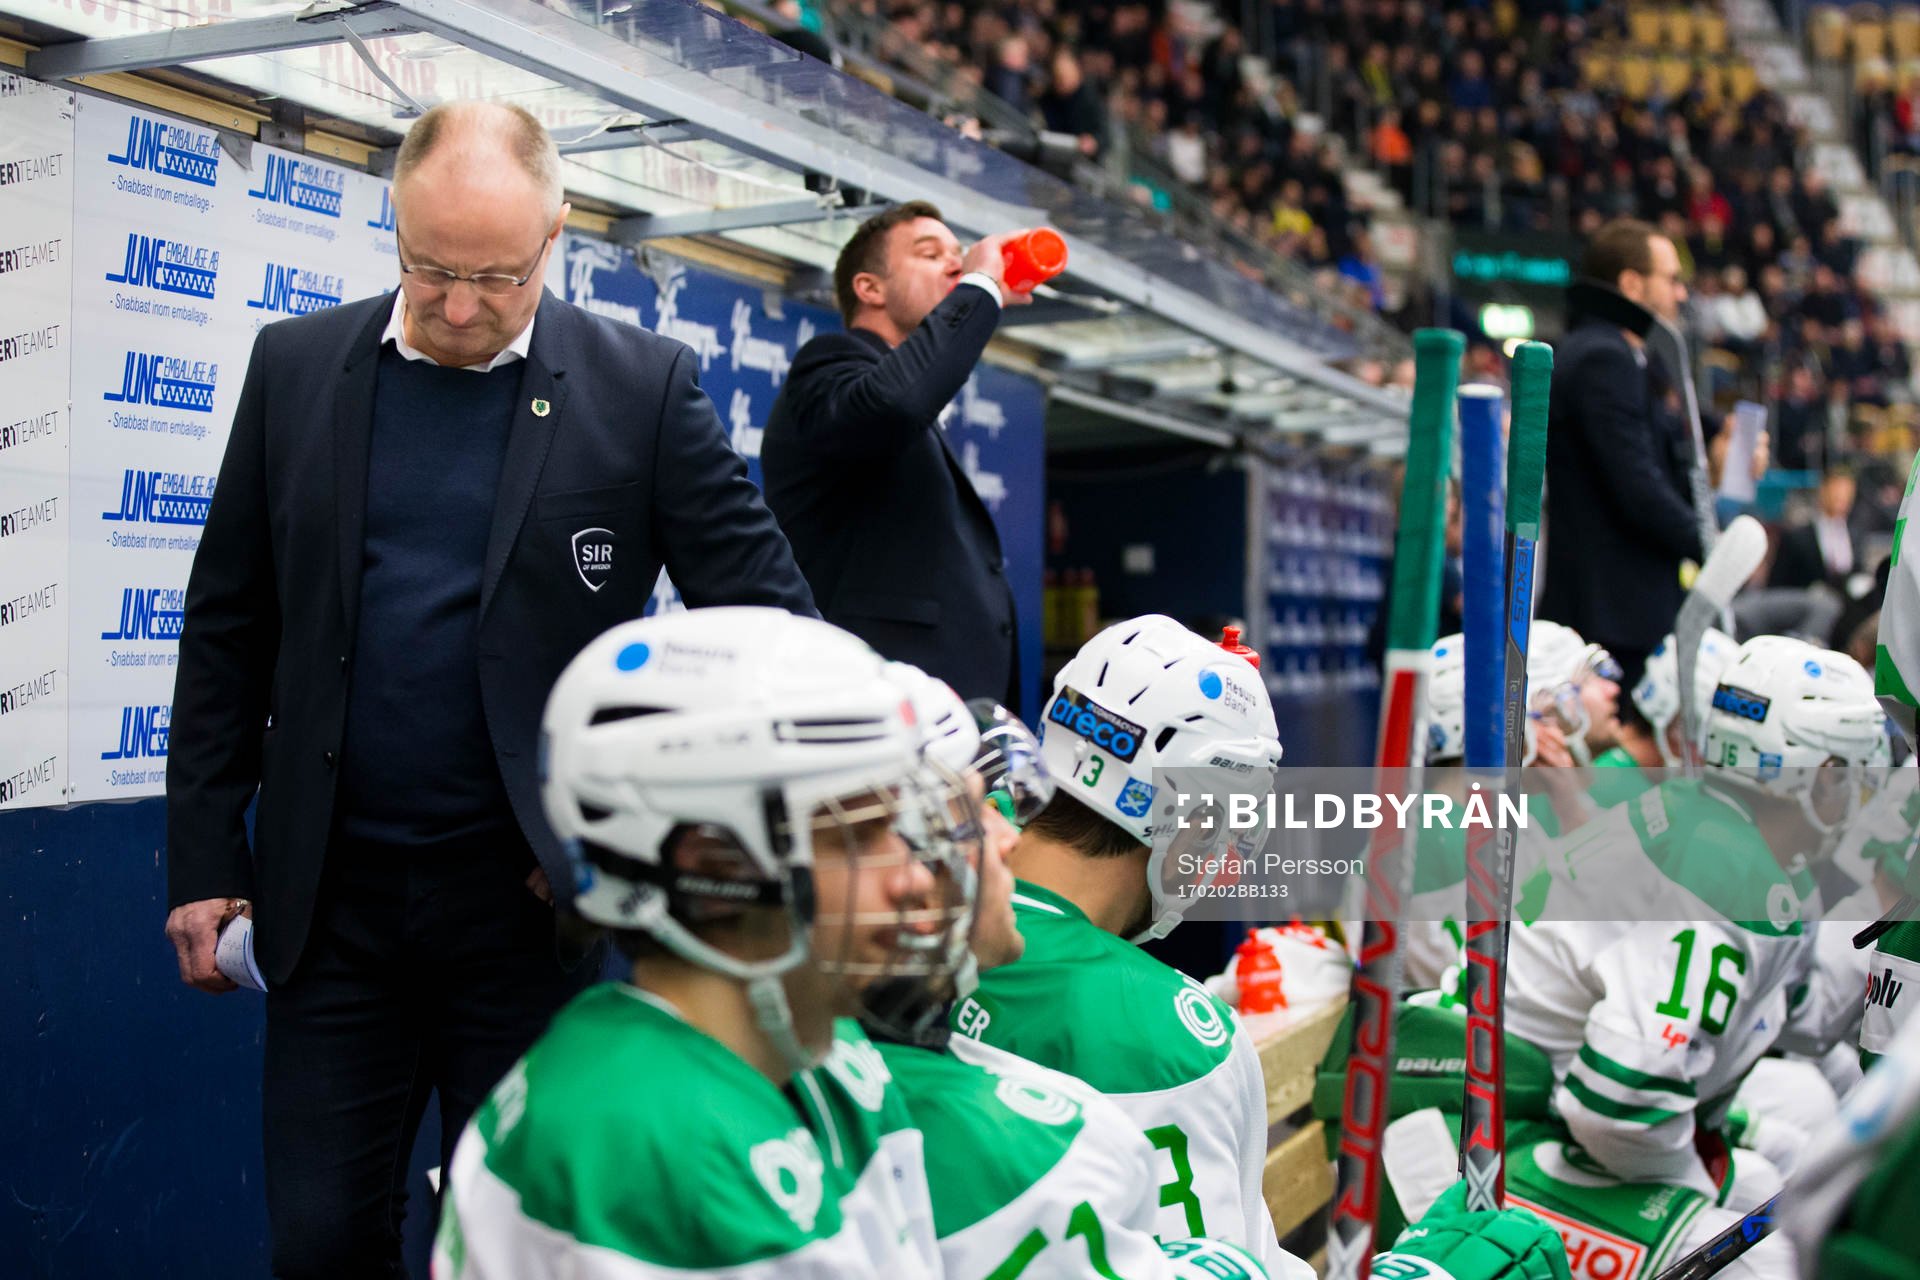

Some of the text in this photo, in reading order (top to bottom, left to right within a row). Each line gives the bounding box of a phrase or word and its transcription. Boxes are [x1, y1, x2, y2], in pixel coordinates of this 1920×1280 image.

[108, 116, 168, 174] JUNE
[168, 126, 210, 156] EMBALLAGE
[117, 174, 210, 213] Snabbast inom emballage
[248, 154, 299, 207] JUNE
[300, 162, 336, 189] EMBALLAGE
[256, 208, 336, 243] Snabbast inom emballage
[106, 233, 219, 290] JUNE EMBALLAGE AB
[247, 263, 298, 315] JUNE
[299, 269, 335, 293] EMBALLAGE
[115, 293, 208, 327] Snabbast inom emballage
[104, 351, 218, 406] JUNE EMBALLAGE AB
[113, 412, 206, 440] Snabbast inom emballage
[102, 469, 162, 523] JUNE
[162, 473, 205, 496] EMBALLAGE
[112, 531, 148, 549] Snabbast
[149, 534, 167, 549] inom
[582, 544, 613, 562] SIR
[101, 588, 160, 640] JUNE
[111, 650, 147, 667] Snabbast
[148, 652, 166, 665] inom
[1224, 694, 1249, 717] Bank
[1225, 677, 1257, 707] Resurs
[101, 706, 160, 760] JUNE
[1051, 697, 1135, 757] areco
[1082, 754, 1105, 788] 3
[1209, 756, 1254, 773] BAUER
[1721, 741, 1738, 767] 16
[111, 770, 148, 786] Snabbast
[1466, 827, 1500, 1153] VAPOR
[1655, 928, 1746, 1036] 16
[1334, 831, 1400, 1222] VAPOR
